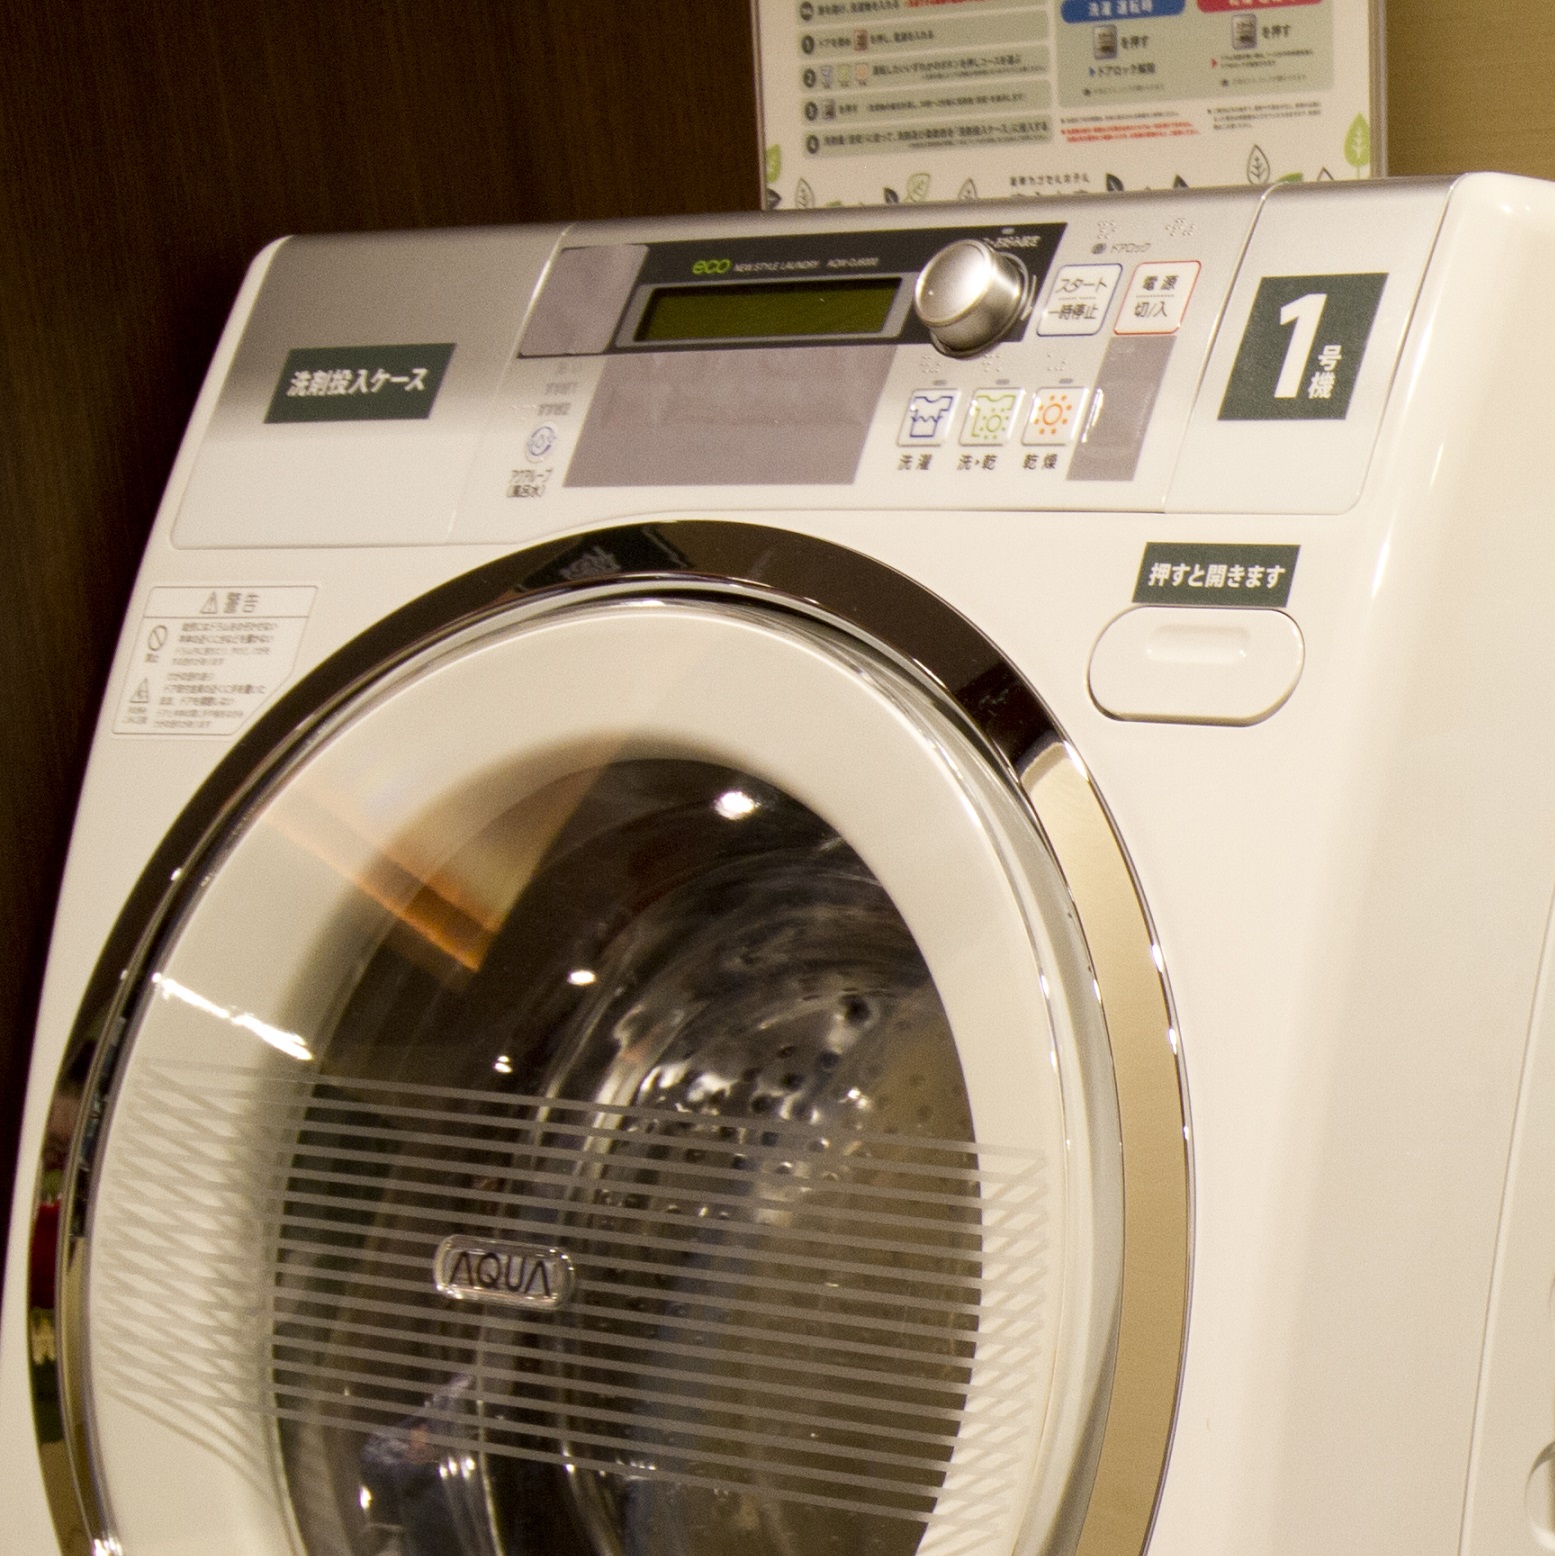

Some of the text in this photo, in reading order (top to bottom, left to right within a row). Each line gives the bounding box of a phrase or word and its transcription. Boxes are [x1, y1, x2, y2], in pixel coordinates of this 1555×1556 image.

[692, 258, 731, 276] eco
[1055, 276, 1108, 294] スタート
[1141, 274, 1180, 292] 電源
[1047, 302, 1100, 322] 一時停止
[1133, 300, 1169, 320] 切/入
[1274, 293, 1328, 398] 1
[286, 366, 430, 398] 洗剤投入ケース
[898, 454, 933, 471] 洗濯
[1147, 561, 1287, 590] 押すと開きます
[450, 1251, 550, 1297] AQUA
